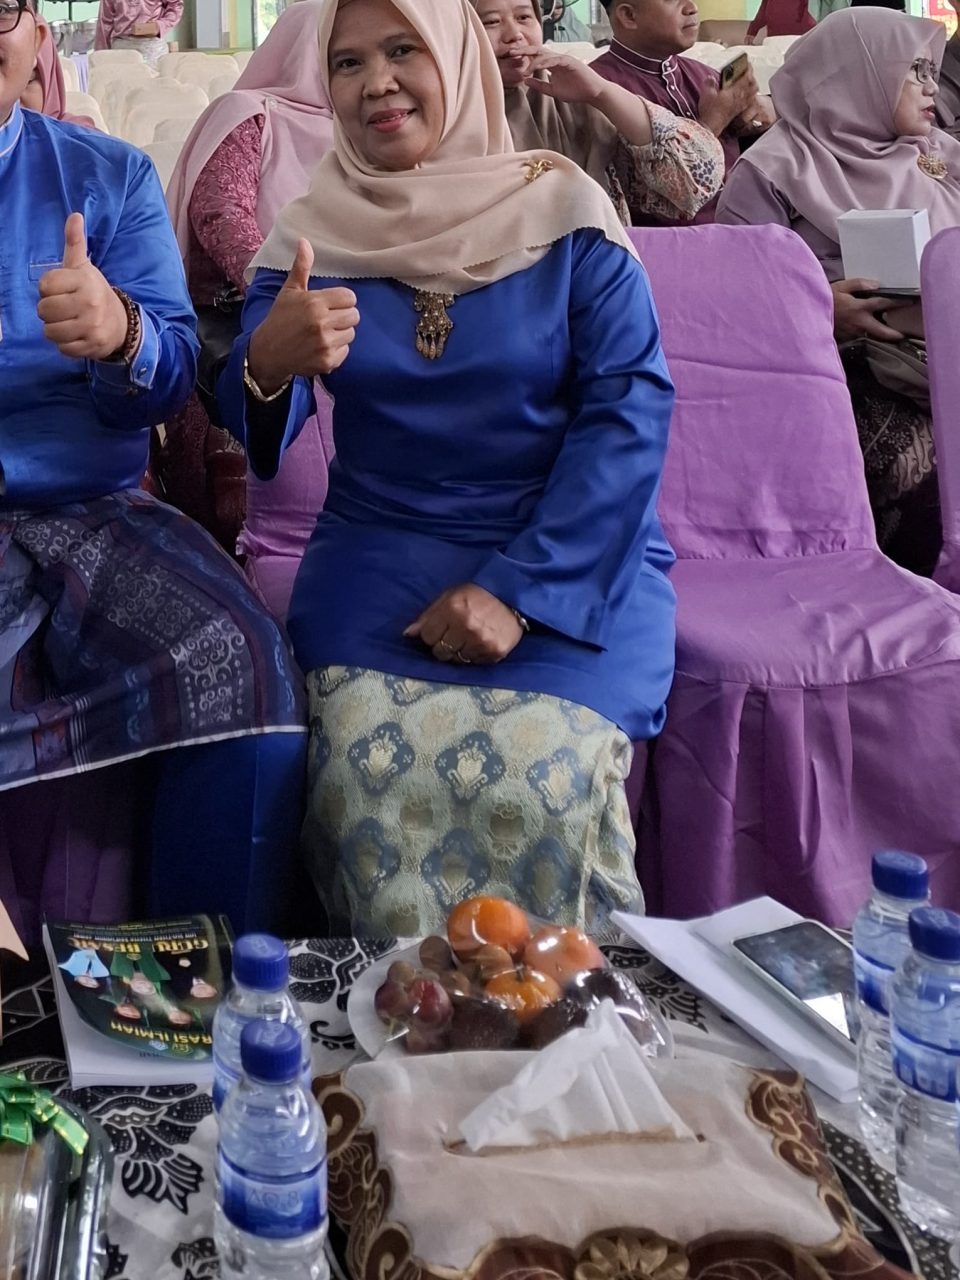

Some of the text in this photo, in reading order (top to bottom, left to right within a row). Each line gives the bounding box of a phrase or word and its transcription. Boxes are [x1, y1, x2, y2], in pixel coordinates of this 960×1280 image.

[152, 938, 208, 954] GURU
[110, 1021, 213, 1045] RASI ILMIAH
